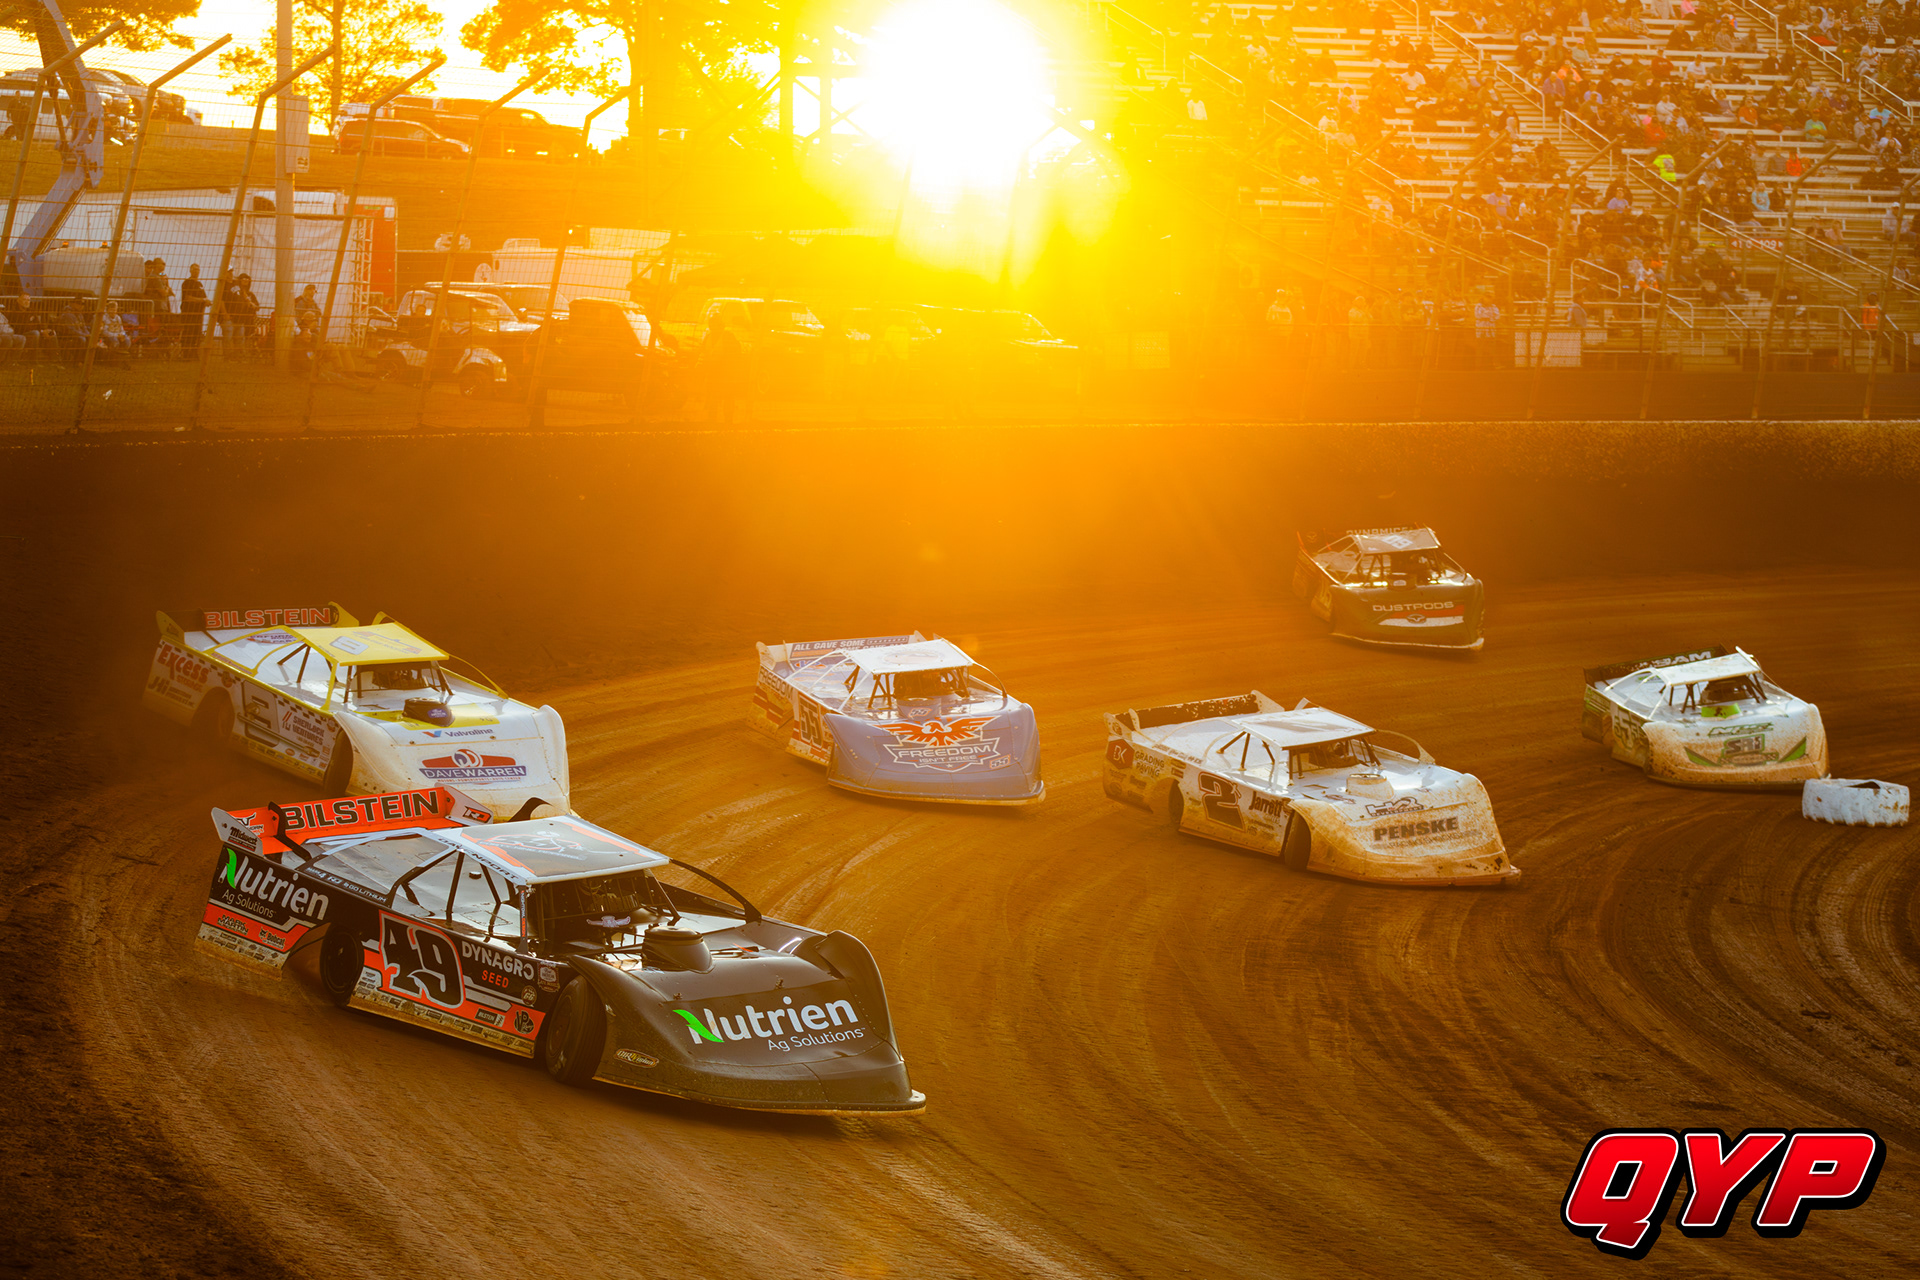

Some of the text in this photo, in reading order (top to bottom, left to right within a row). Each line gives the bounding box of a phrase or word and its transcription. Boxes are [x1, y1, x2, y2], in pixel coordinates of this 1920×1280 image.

[1372, 601, 1455, 612] DUSTPODS
[204, 607, 331, 629] BILSTEIN
[794, 640, 866, 652] ALL GAVE SOME
[157, 643, 209, 684] Excess
[292, 724, 323, 745] VENTURES
[293, 716, 325, 737] SHERLOCK
[444, 729, 494, 737] Valvoline
[898, 745, 991, 758] FREEDOM
[1135, 751, 1165, 768] GRADING
[1135, 762, 1160, 777] PAVING
[282, 790, 440, 831] BILSTEIN
[1248, 791, 1283, 817] Jarrett
[230, 826, 258, 845] Midwest
[1374, 817, 1459, 841] PENSKE
[217, 847, 330, 920] Nutrien
[222, 889, 275, 918] Ag Solutions
[461, 940, 534, 980] DYNAGRO
[481, 969, 509, 988] SEED
[478, 1011, 496, 1022] BILSTEIN
[672, 996, 859, 1045] Nutrien
[767, 1027, 864, 1052] Ag Solutions
